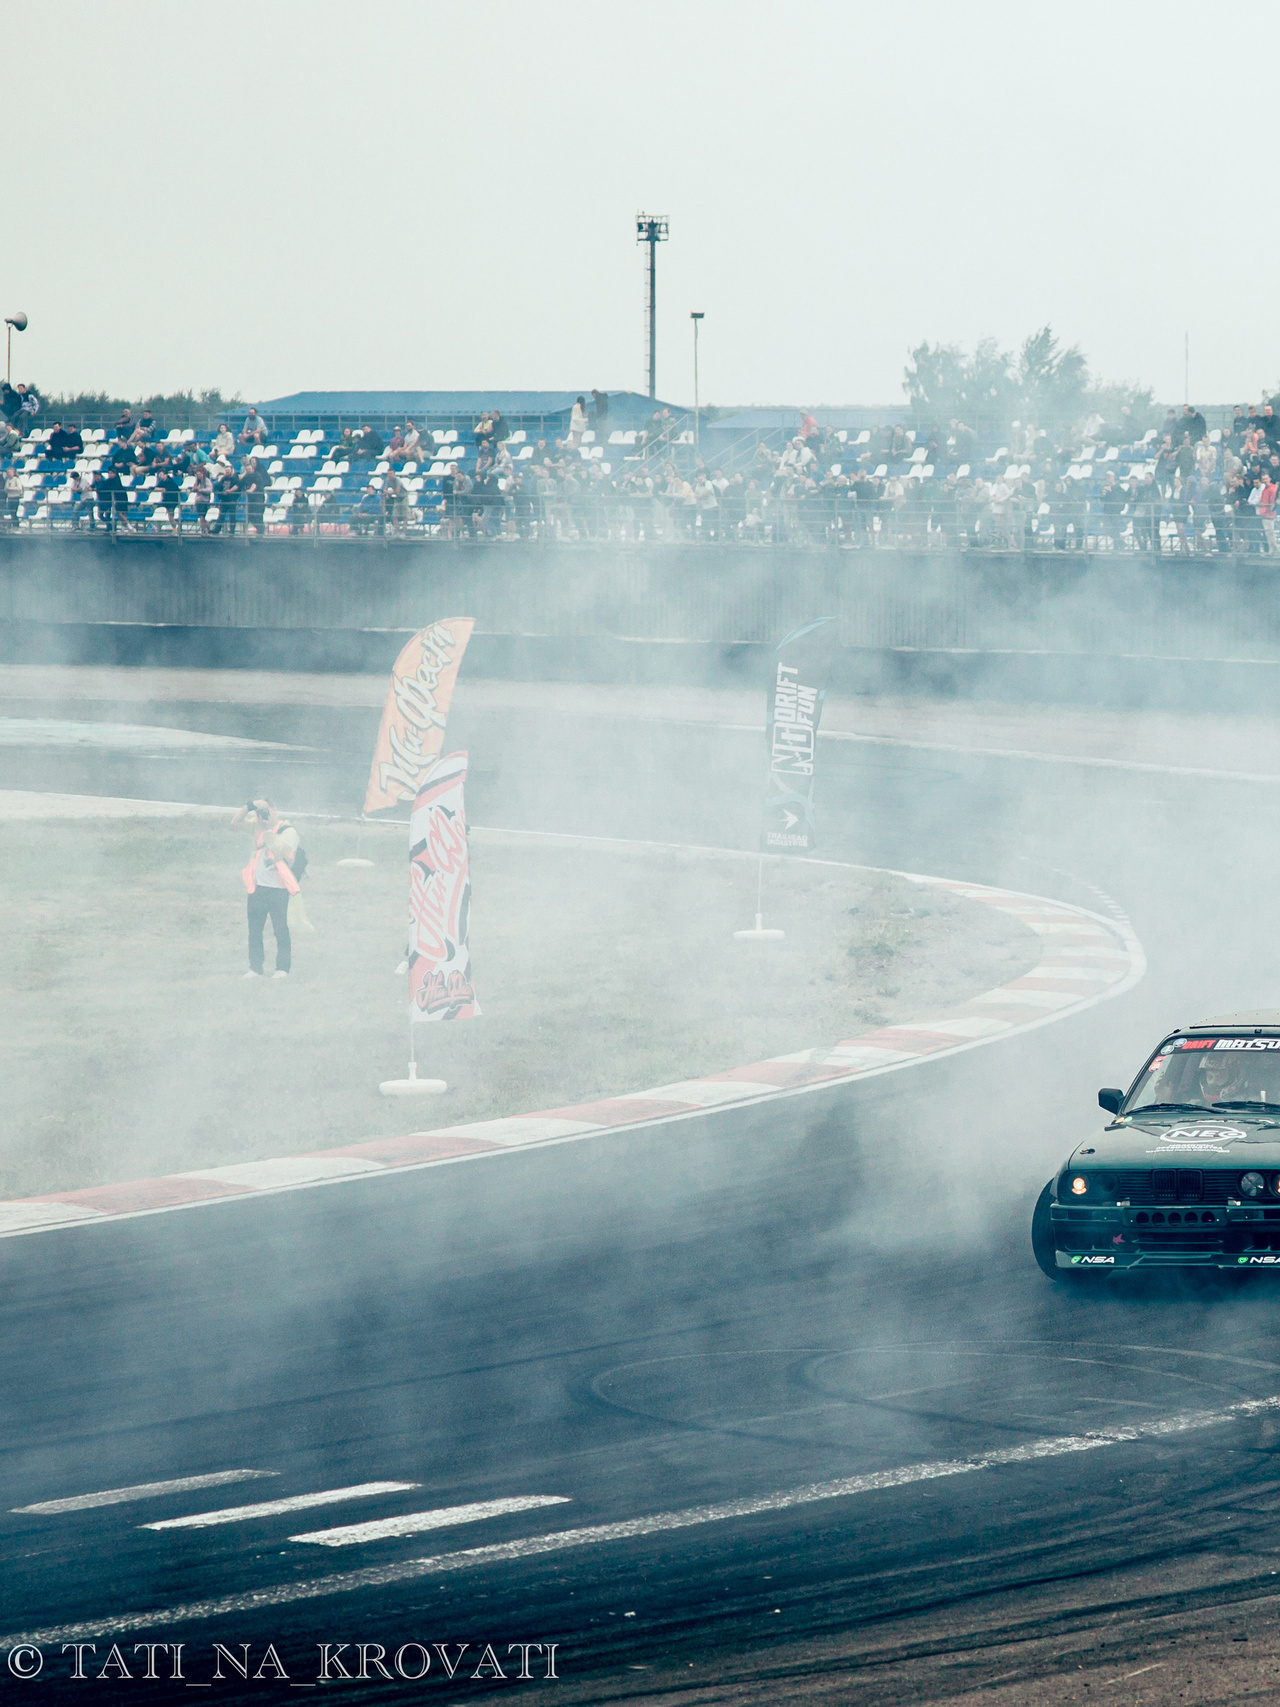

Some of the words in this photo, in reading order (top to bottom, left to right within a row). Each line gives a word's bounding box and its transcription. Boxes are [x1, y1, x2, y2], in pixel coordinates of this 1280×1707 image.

[774, 661, 799, 723] DRIFT
[796, 684, 818, 727] FUN
[1181, 1040, 1216, 1050] DRIFT
[1081, 1256, 1115, 1264] NSA
